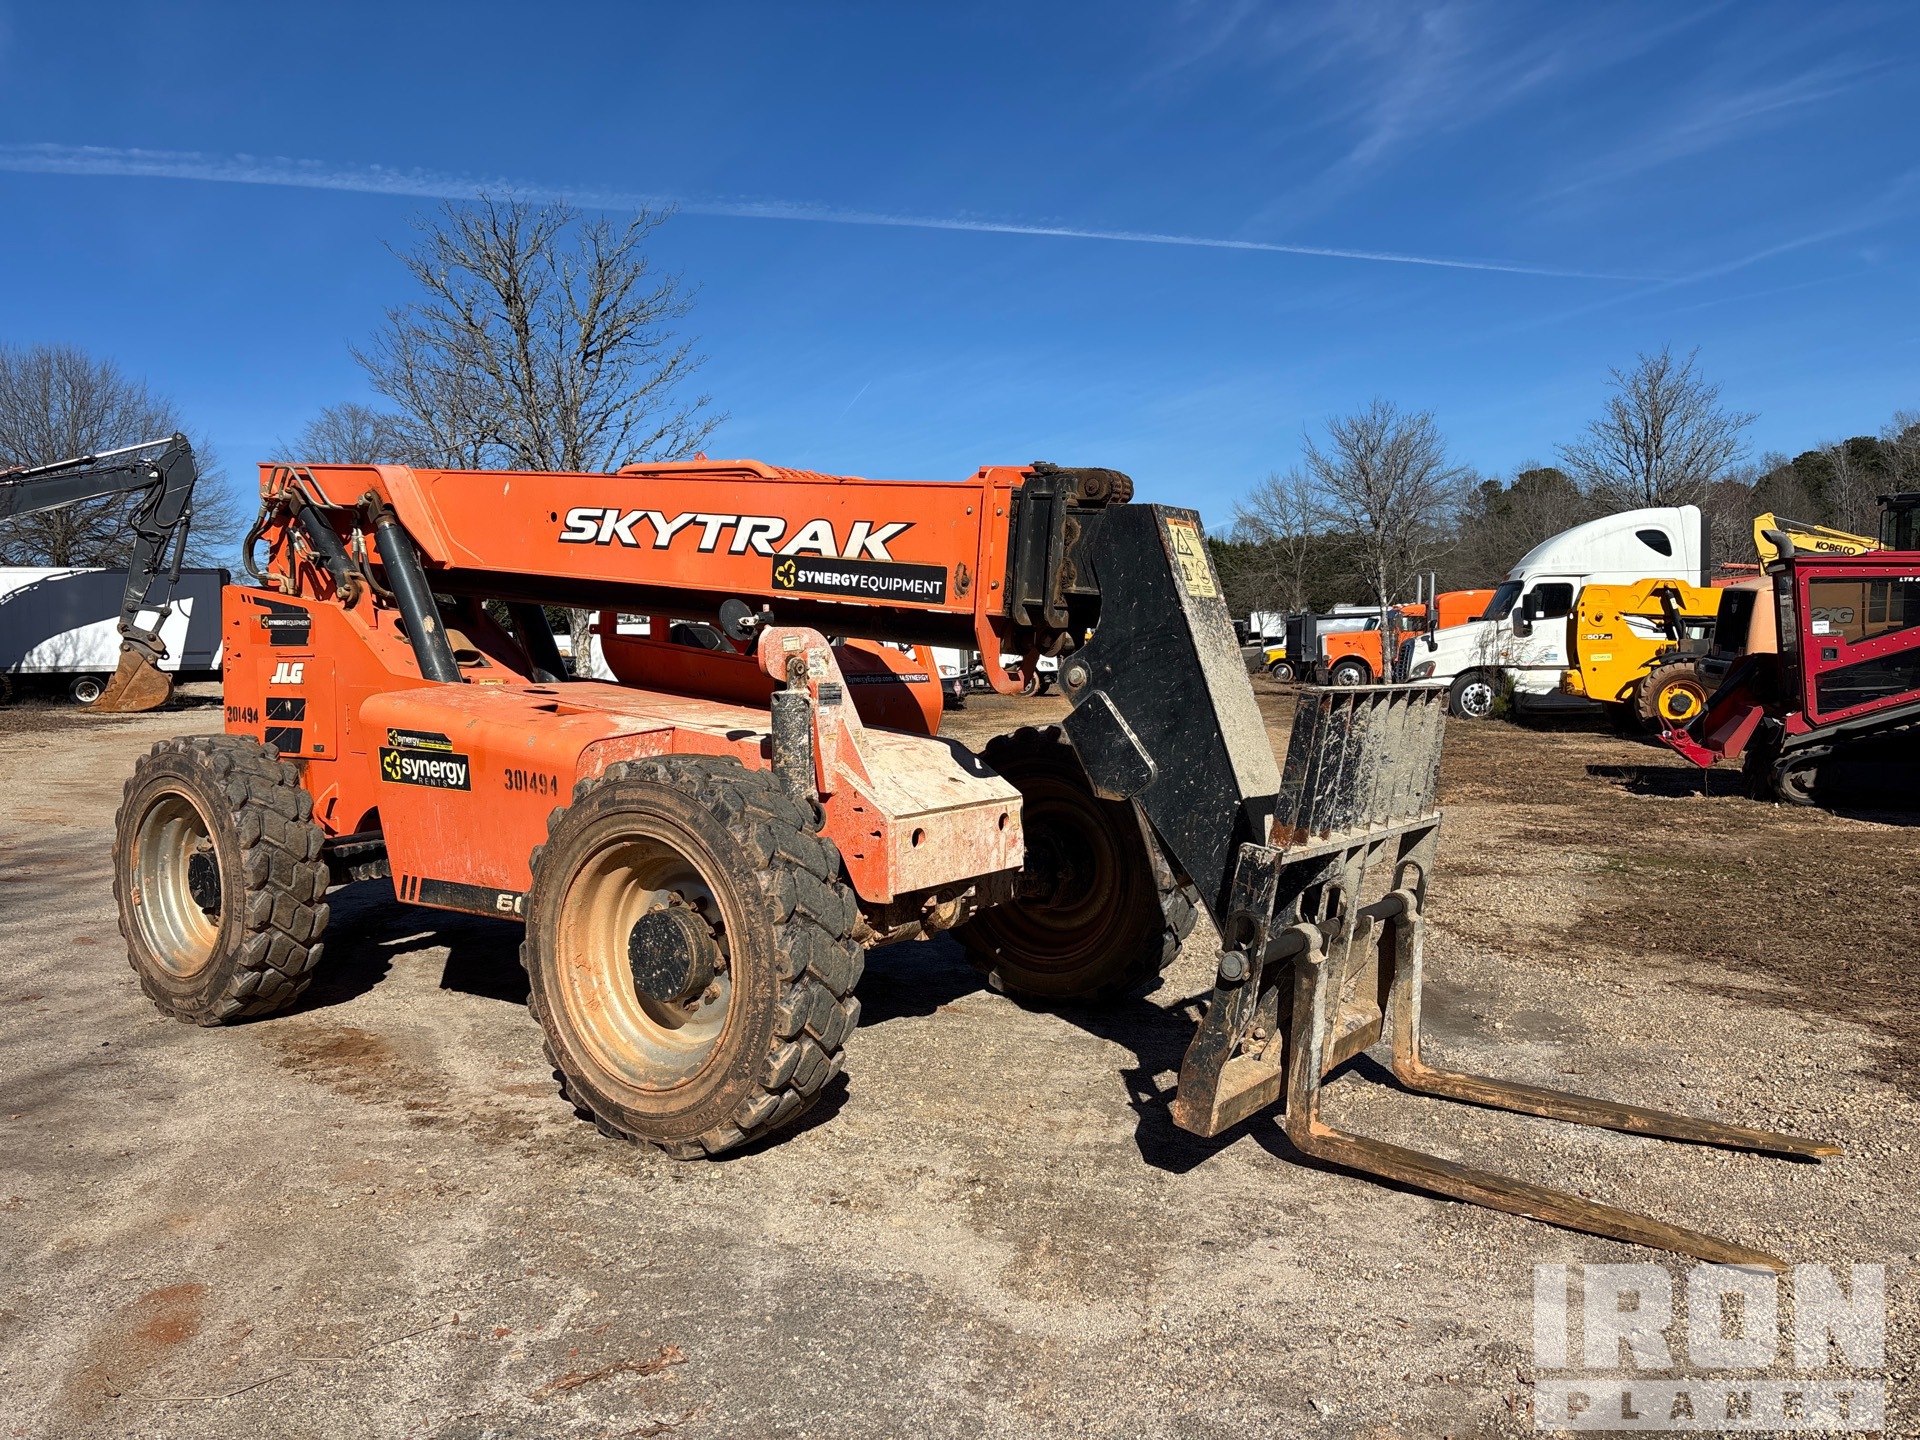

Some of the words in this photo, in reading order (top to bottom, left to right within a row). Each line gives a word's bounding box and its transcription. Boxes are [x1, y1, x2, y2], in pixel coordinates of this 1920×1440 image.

[558, 506, 917, 562] SKYTRAK
[1815, 540, 1856, 556] KOBELCO
[270, 662, 304, 684] JLG
[226, 705, 259, 724] 301494
[397, 735, 420, 747] synergy
[401, 757, 466, 785] synergy
[418, 777, 448, 788] RENTS
[504, 768, 558, 797] 301494
